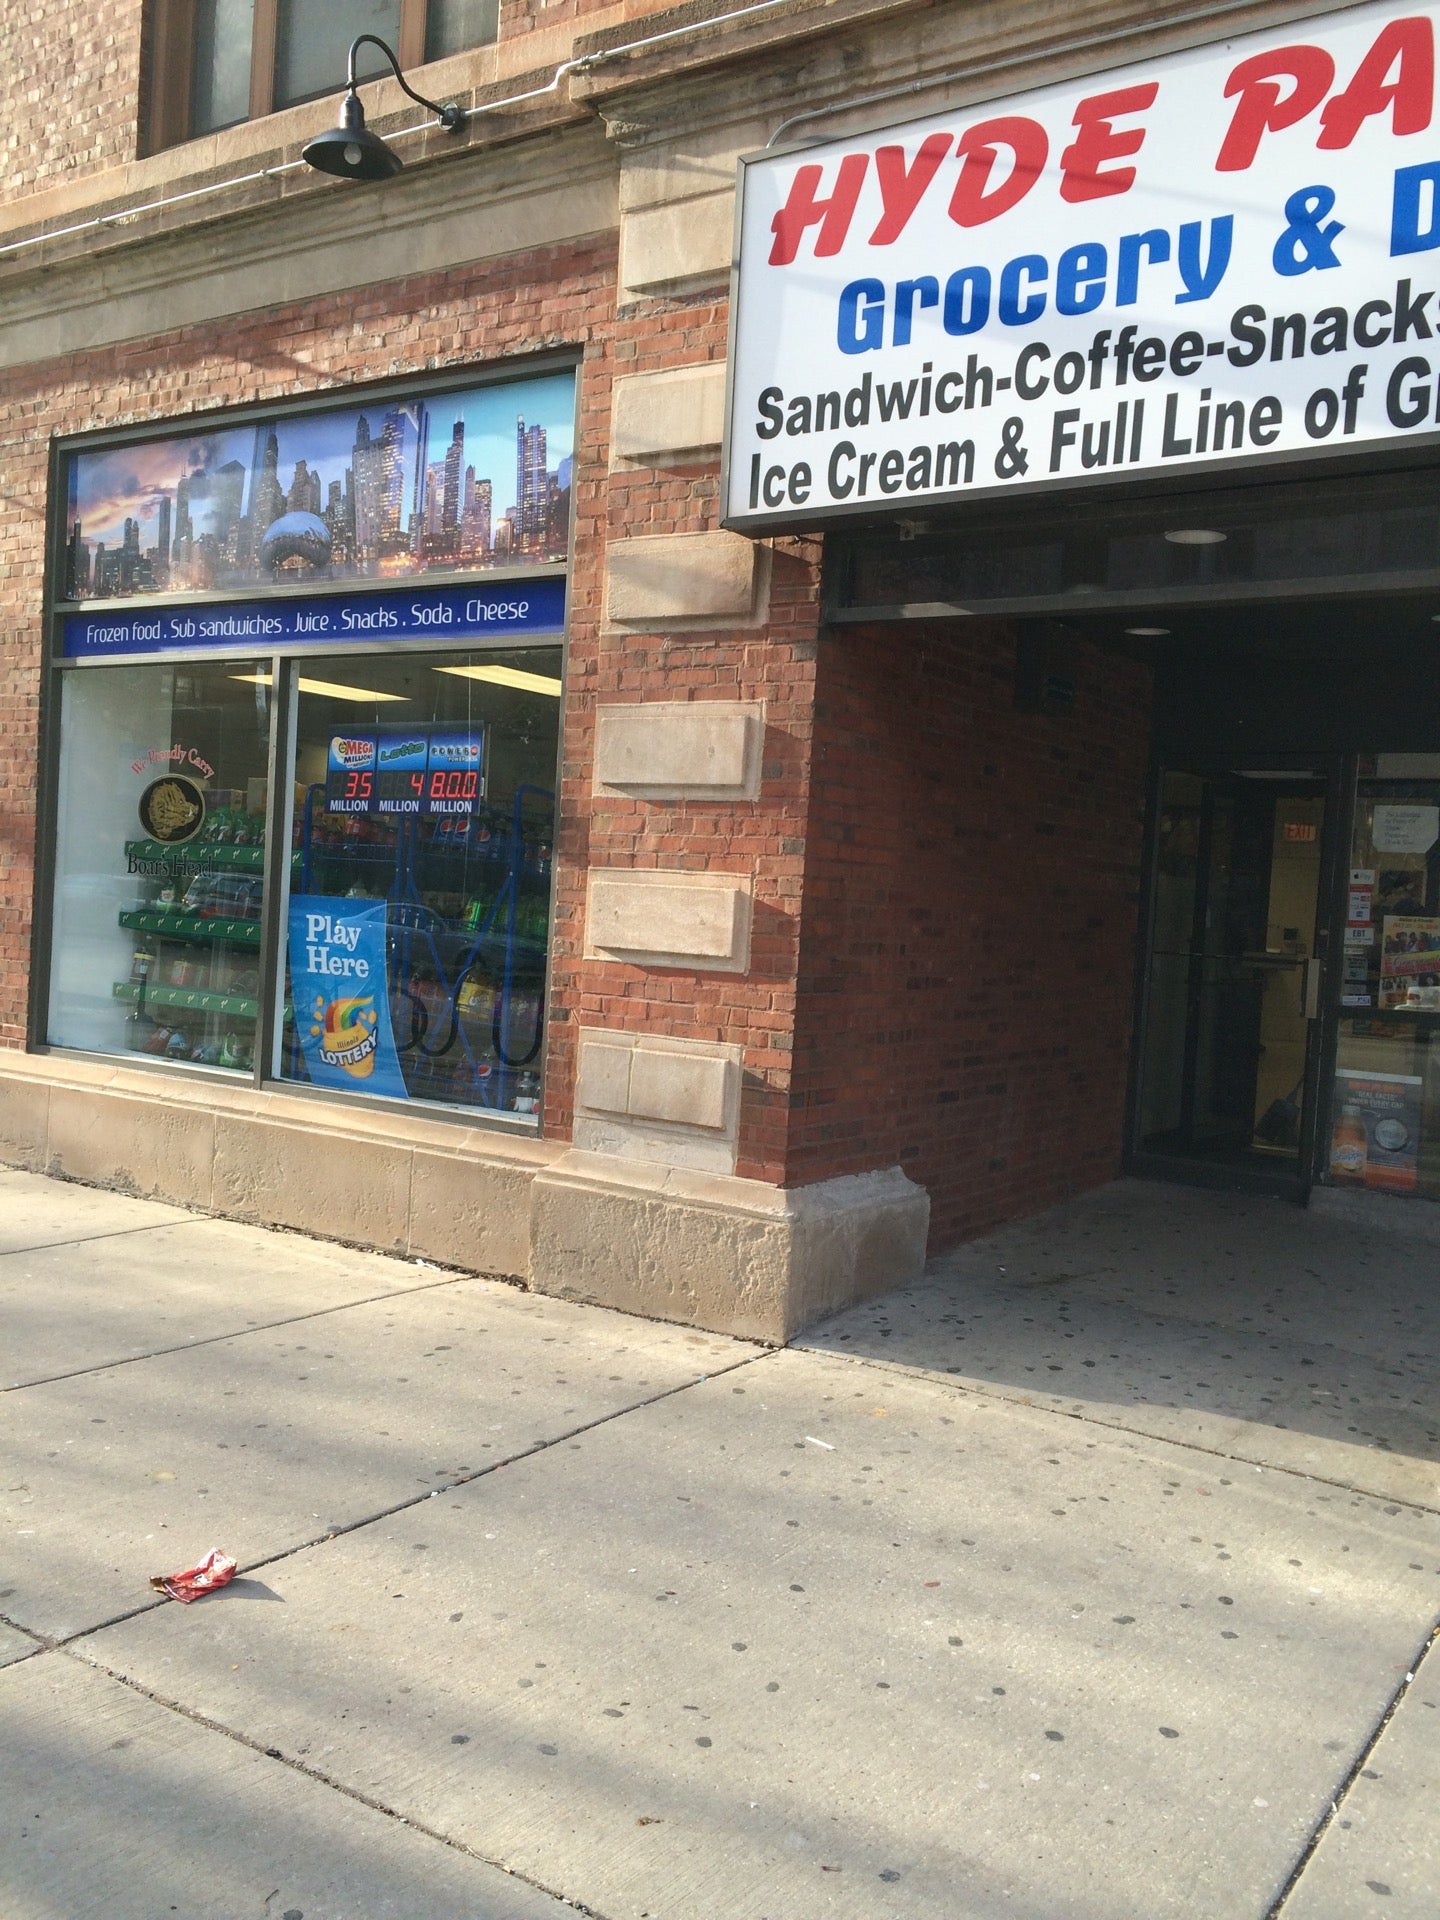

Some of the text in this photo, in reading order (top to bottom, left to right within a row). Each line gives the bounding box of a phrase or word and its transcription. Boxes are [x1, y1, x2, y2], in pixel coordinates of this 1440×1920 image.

[768, 82, 1159, 266] HYDE
[836, 213, 1234, 355] Grocery
[1272, 184, 1345, 278] &
[755, 278, 1440, 440] Sandwich-Coffee-Snack
[749, 355, 1440, 510] Ice Cream & Full Line of G
[86, 600, 530, 644] Frozen food Sub sandwiches Juice Snacks Soda Cheese
[148, 743, 187, 765] Proudly
[345, 740, 373, 755] MEGA
[380, 742, 425, 762] Lotto
[345, 772, 373, 798] 35
[411, 773, 425, 797] 4
[329, 799, 369, 812] MILLION
[379, 800, 420, 813] MILLION
[430, 801, 473, 813] MILLION
[172, 853, 213, 878] Head
[305, 914, 362, 951] Play
[1352, 929, 1366, 938] EBT
[305, 945, 369, 978] Here
[319, 1028, 377, 1066] LOTTERY
